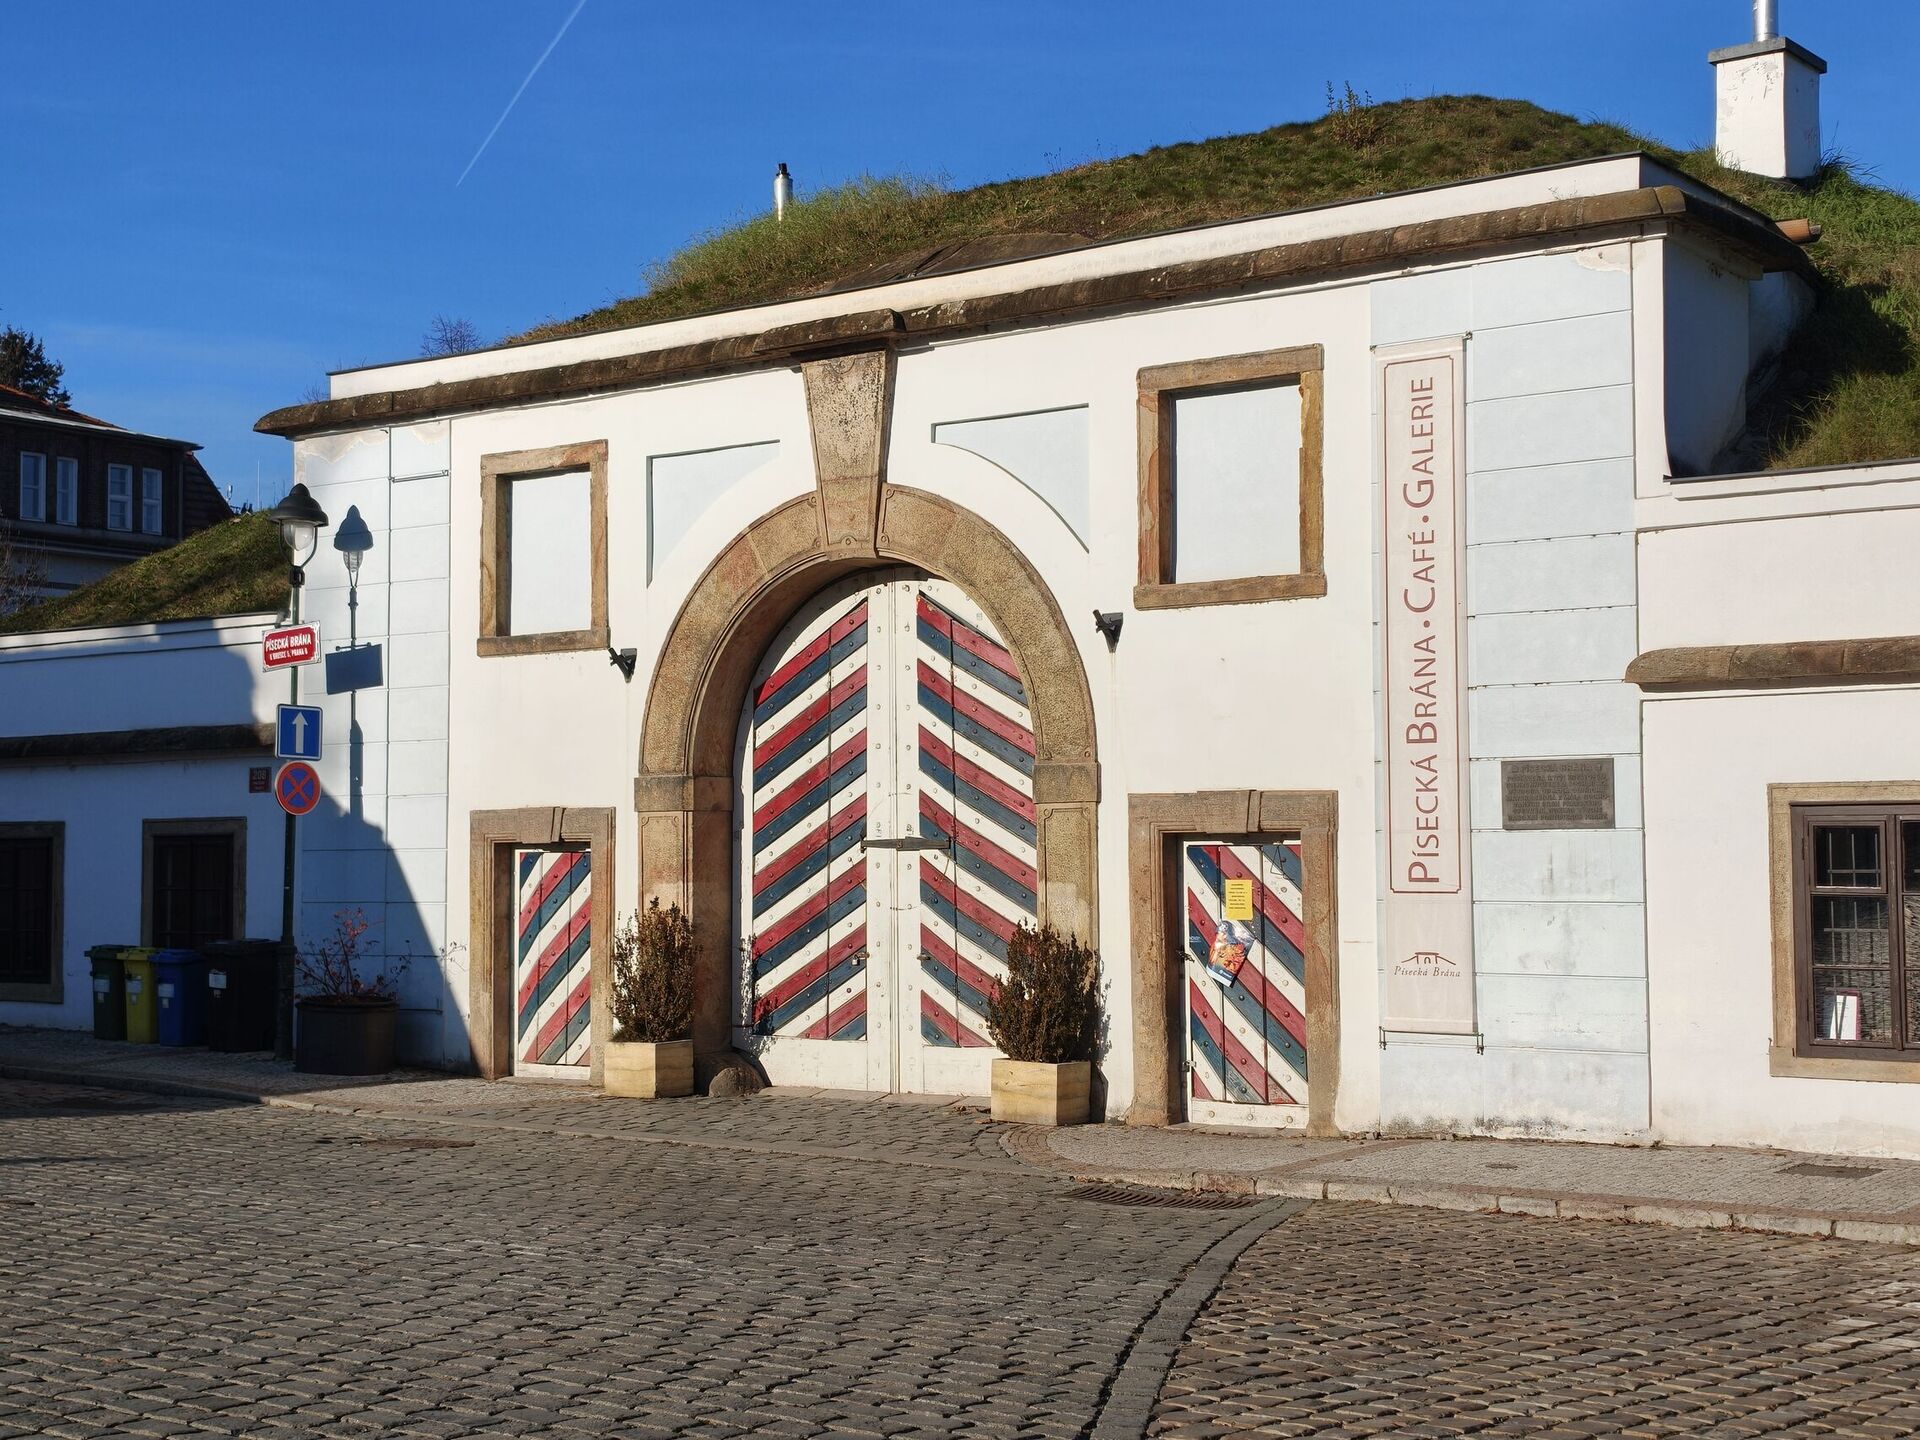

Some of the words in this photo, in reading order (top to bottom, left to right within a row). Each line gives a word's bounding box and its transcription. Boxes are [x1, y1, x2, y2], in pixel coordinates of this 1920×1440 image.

[1402, 376, 1435, 510] GALERIE
[1403, 529, 1436, 615] CAFÉ
[265, 635, 289, 652] PÍSECKÁ
[290, 633, 312, 647] BRÁNA
[1405, 635, 1439, 746] BRÁNA
[1407, 753, 1441, 883] PÍSECKÁ
[1394, 965, 1428, 977] Písecká
[1433, 966, 1461, 977] Brána
